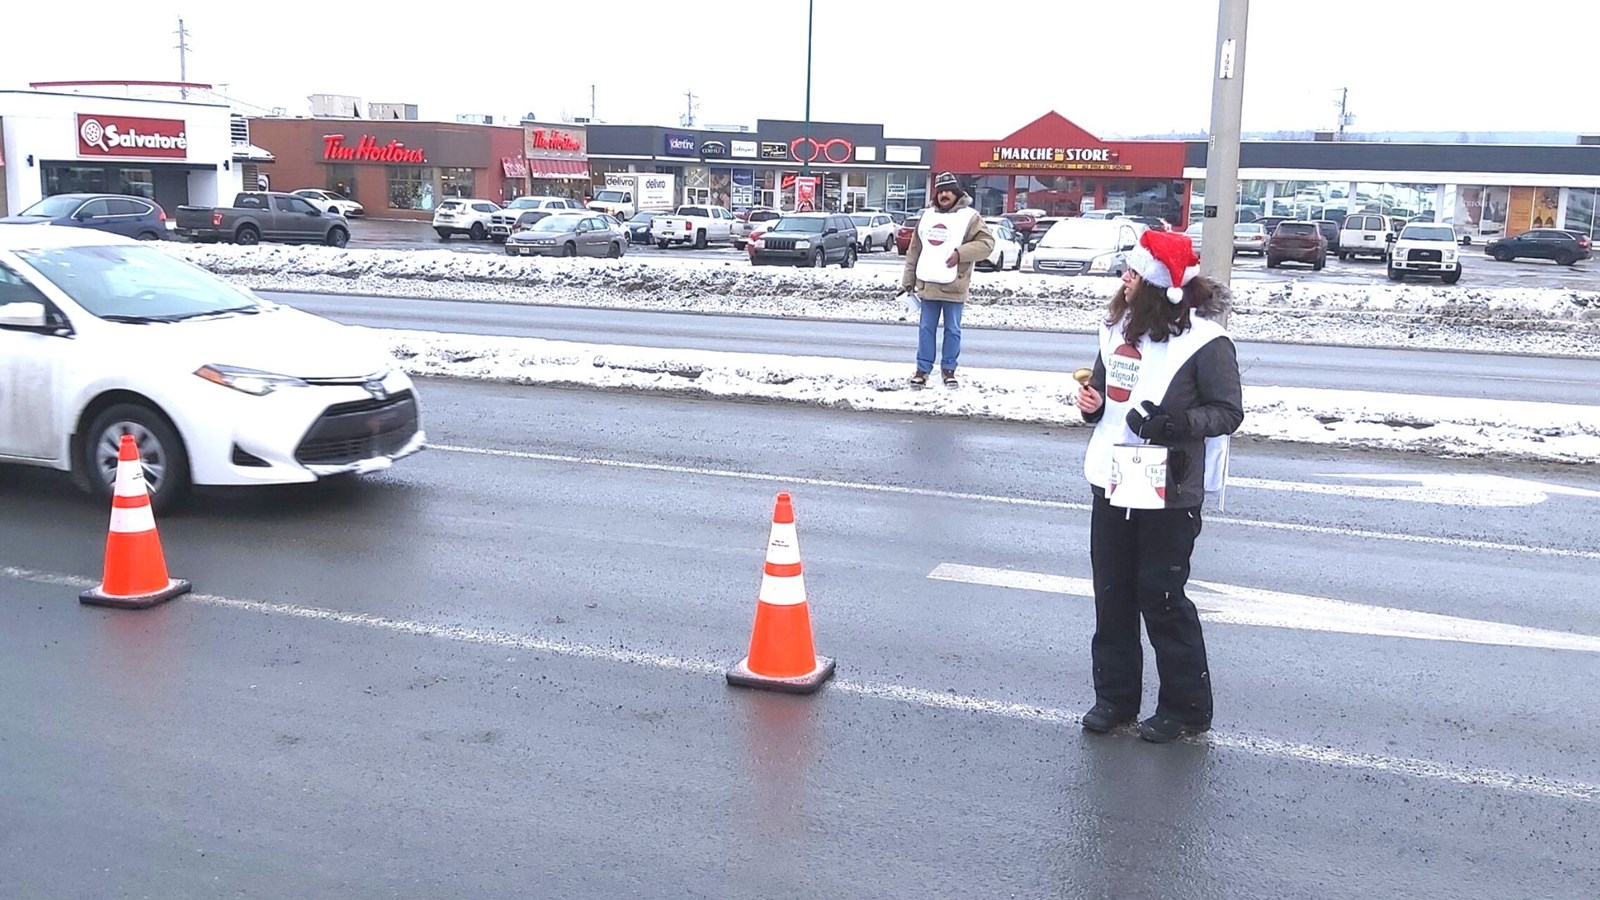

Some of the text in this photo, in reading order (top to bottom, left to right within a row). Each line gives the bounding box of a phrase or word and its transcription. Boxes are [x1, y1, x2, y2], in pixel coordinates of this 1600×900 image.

[104, 124, 187, 149] Salvatoré
[533, 127, 549, 149] Tim
[323, 134, 355, 160] Tim
[1001, 147, 1054, 160] MARCHÉ
[1066, 148, 1109, 161] STORE
[606, 177, 634, 186] delivro
[646, 178, 666, 189] delivro
